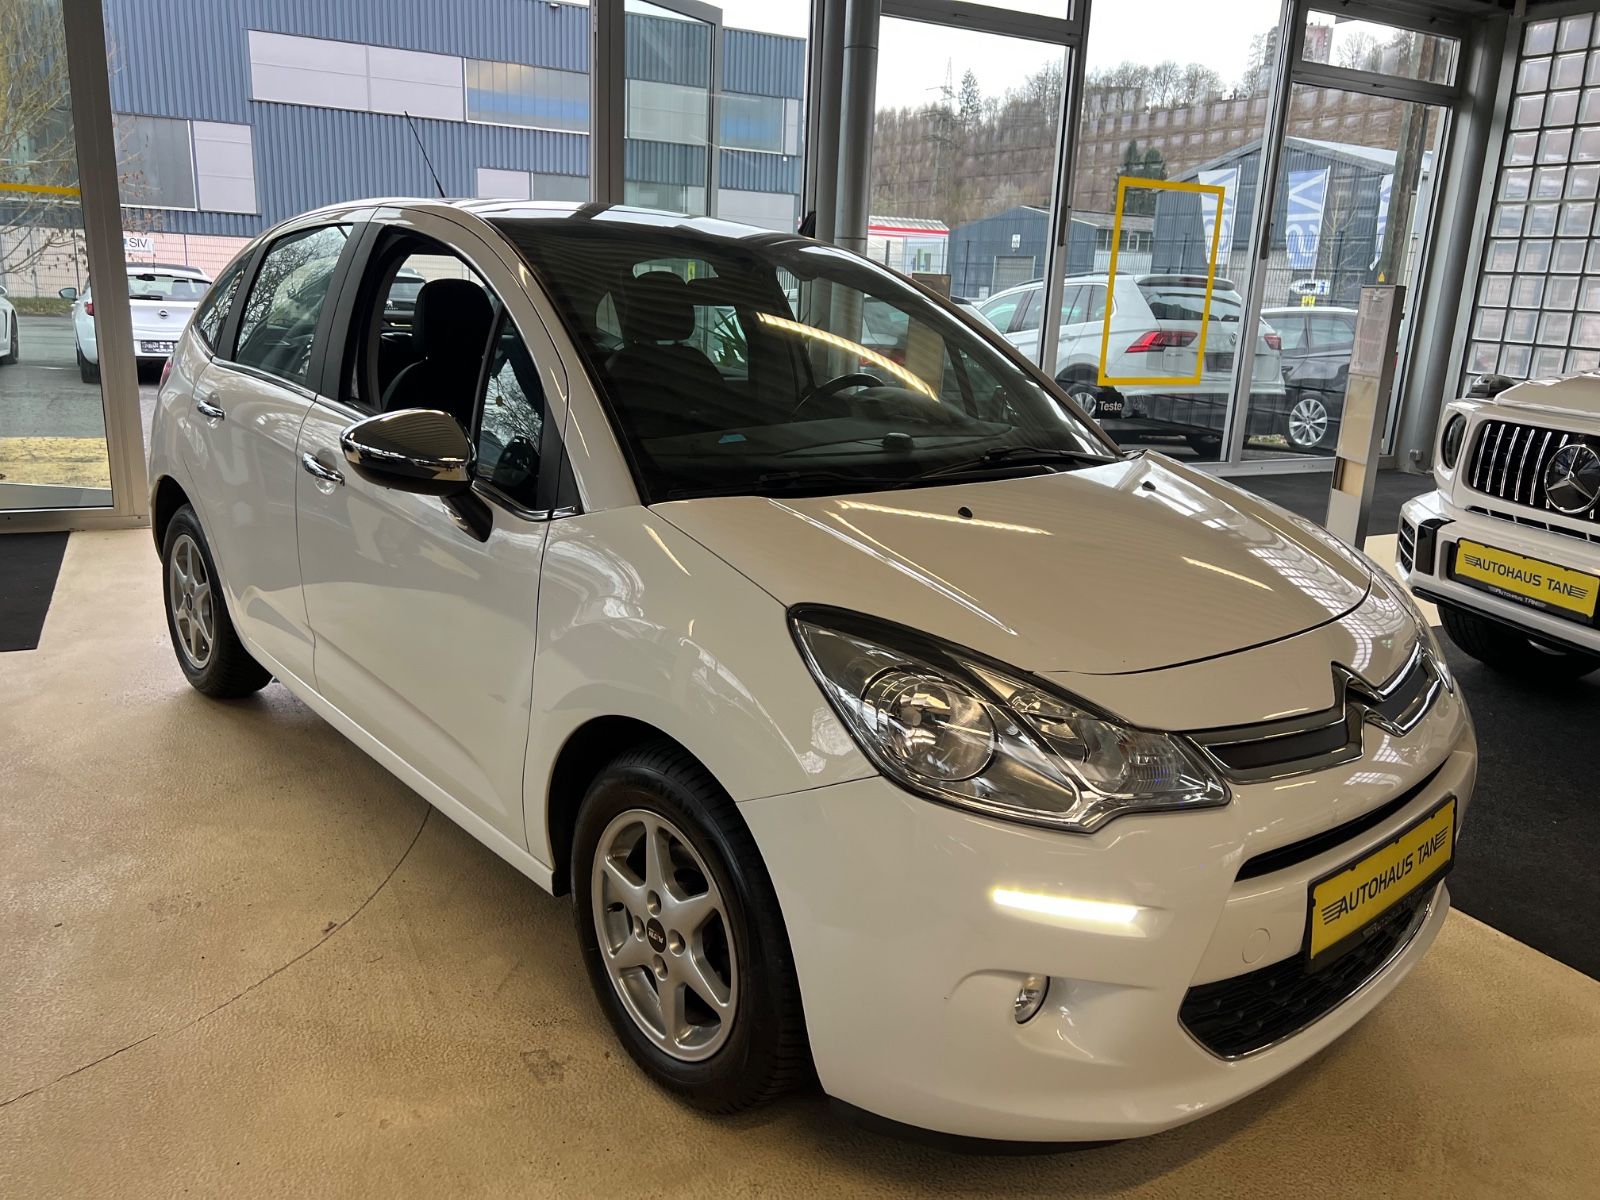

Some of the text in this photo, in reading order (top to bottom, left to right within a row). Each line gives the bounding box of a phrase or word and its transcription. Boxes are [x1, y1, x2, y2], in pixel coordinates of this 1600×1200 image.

[129, 237, 148, 248] SIV
[1099, 400, 1123, 411] Teste
[1474, 556, 1573, 596] AUTOHAUS TAN
[1337, 852, 1413, 919] AUTOHAUS
[1418, 833, 1439, 865] TAN
